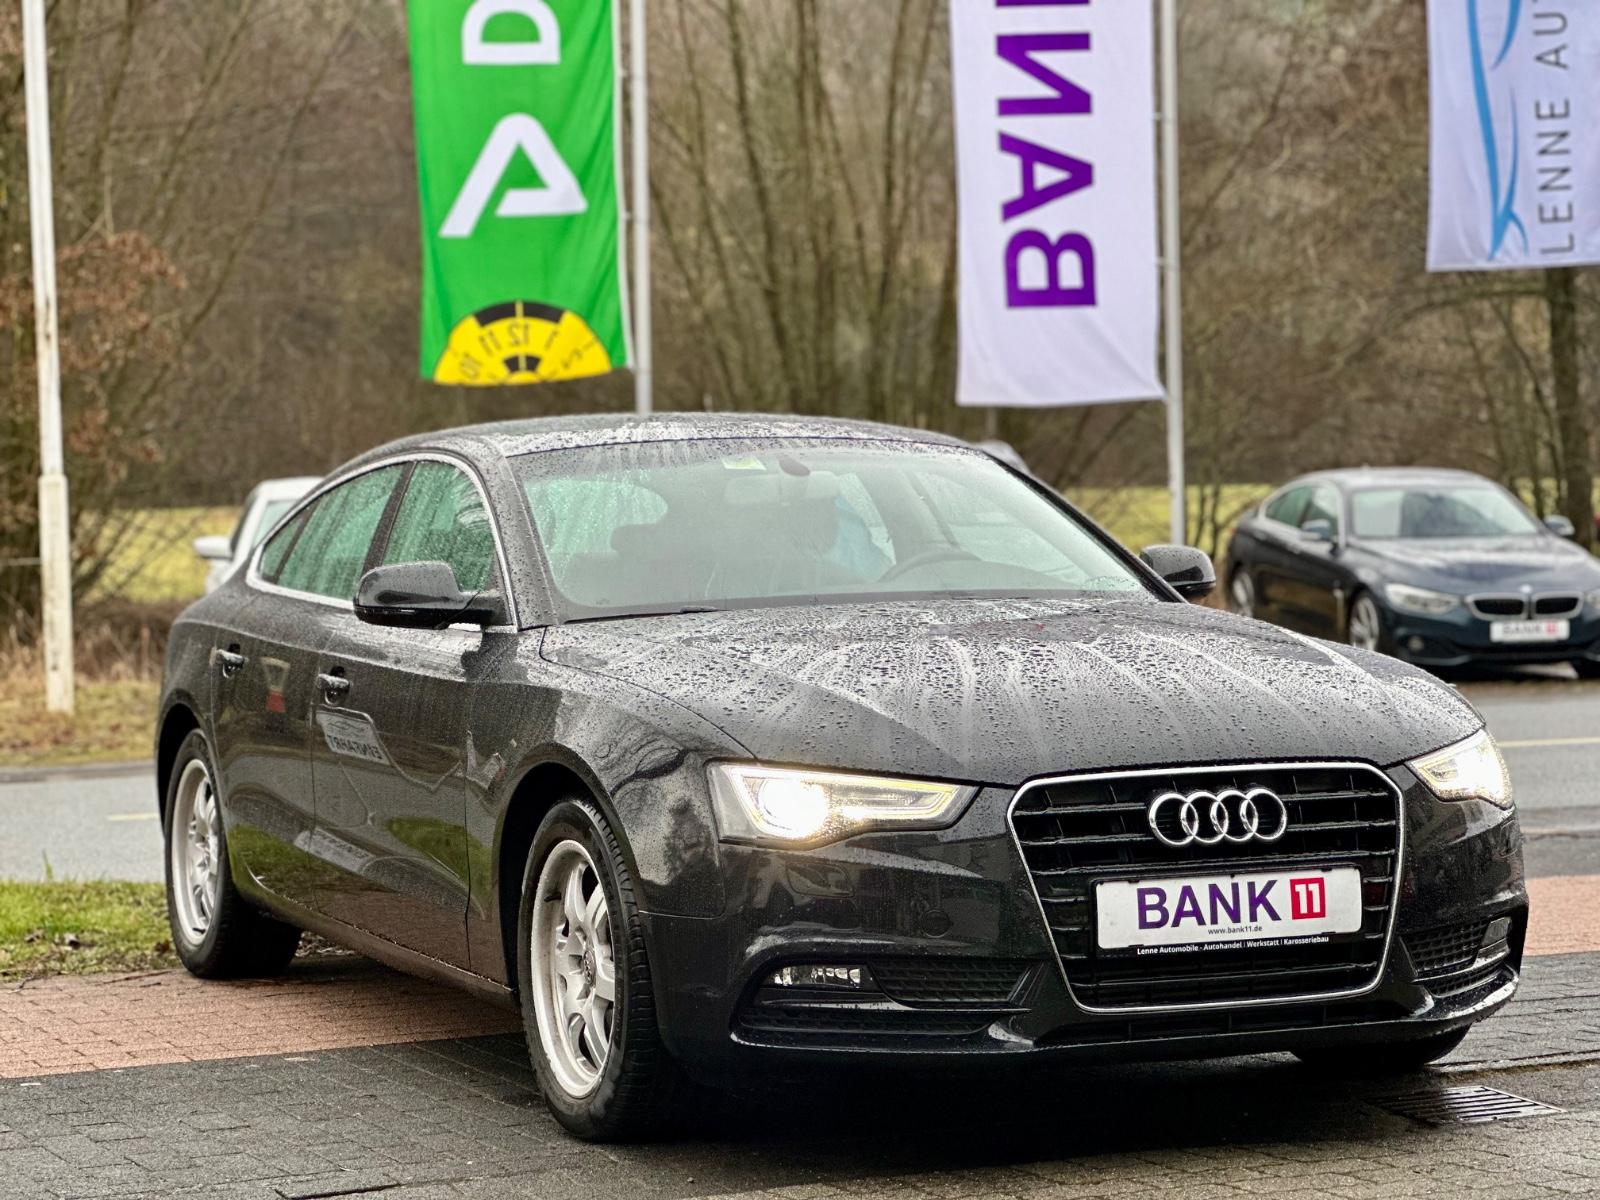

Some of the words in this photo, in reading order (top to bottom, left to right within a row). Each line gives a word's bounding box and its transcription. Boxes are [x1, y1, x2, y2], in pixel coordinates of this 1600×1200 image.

[1532, 0, 1569, 71] AU
[1535, 98, 1575, 255] LENNE
[1136, 879, 1282, 930] BANK
[1294, 882, 1321, 915] 11
[1207, 925, 1263, 935] www.bank11.de
[1137, 947, 1159, 955] Lenne
[1159, 943, 1199, 954] Automobile
[1203, 941, 1242, 951] Autohandel
[1246, 938, 1280, 948] Werkstatt
[1283, 935, 1330, 946] Karosseriebau
